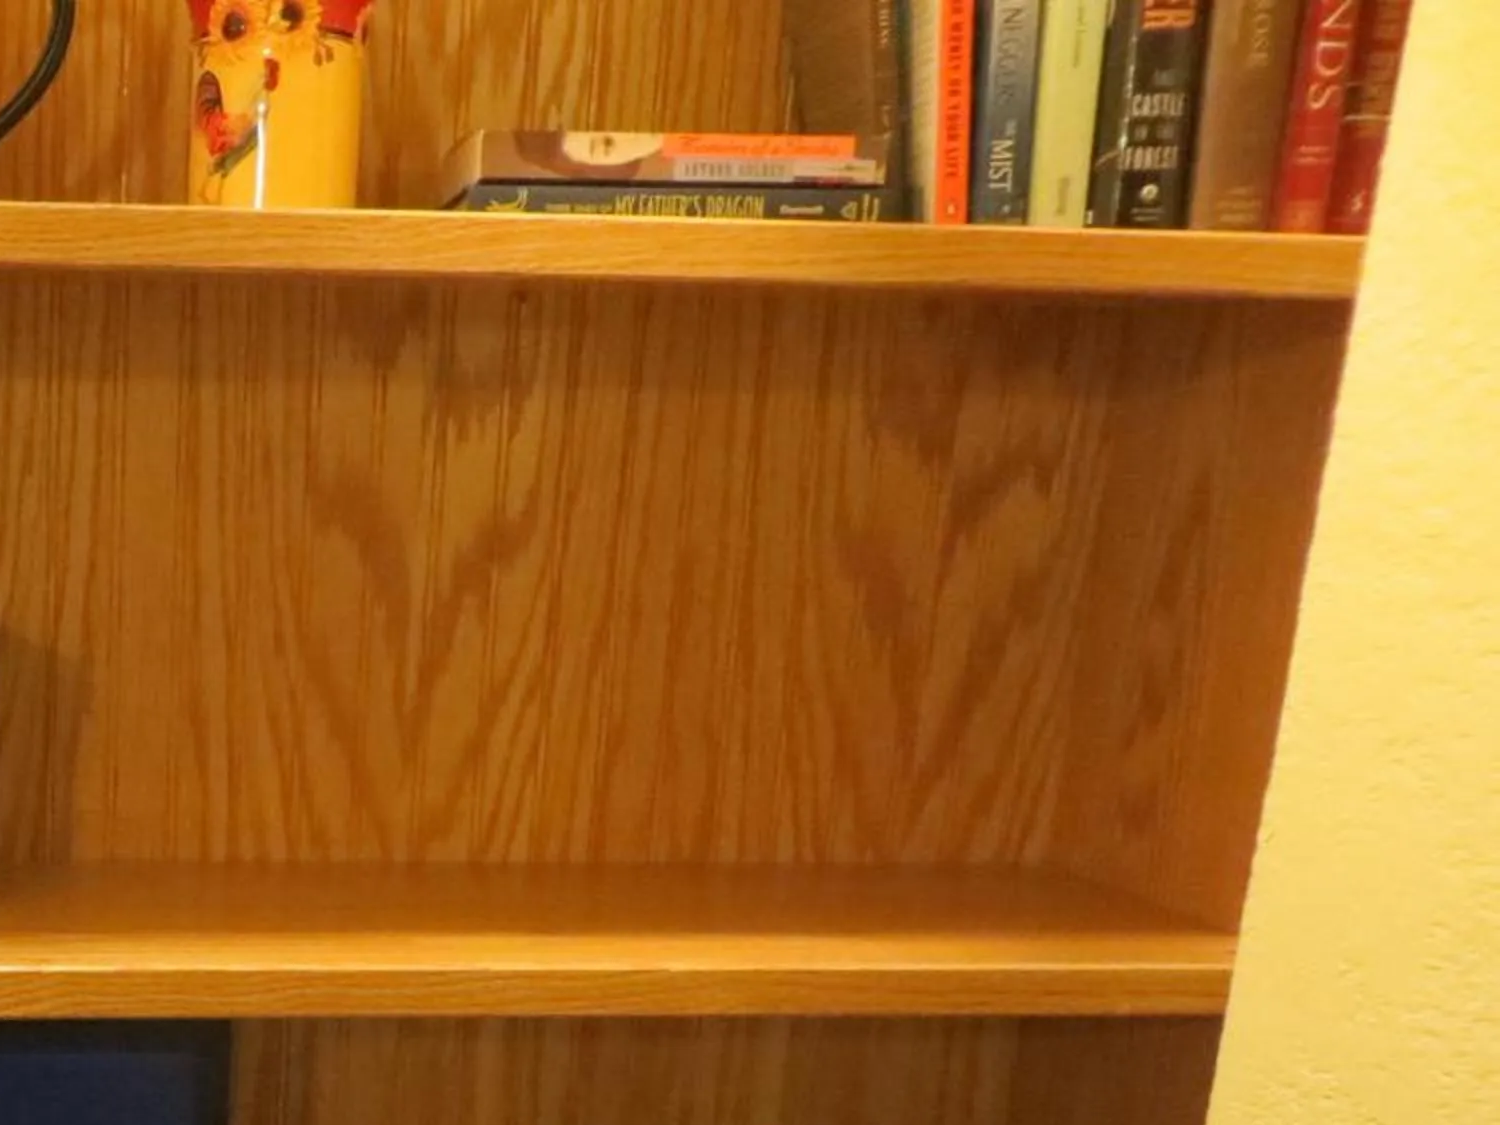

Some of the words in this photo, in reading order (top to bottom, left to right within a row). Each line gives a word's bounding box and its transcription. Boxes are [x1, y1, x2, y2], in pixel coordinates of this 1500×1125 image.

[1131, 93, 1186, 116] CASTLE
[988, 137, 1015, 192] MIST
[637, 195, 702, 217] FATHER'S
[705, 195, 765, 218] DRAGON
